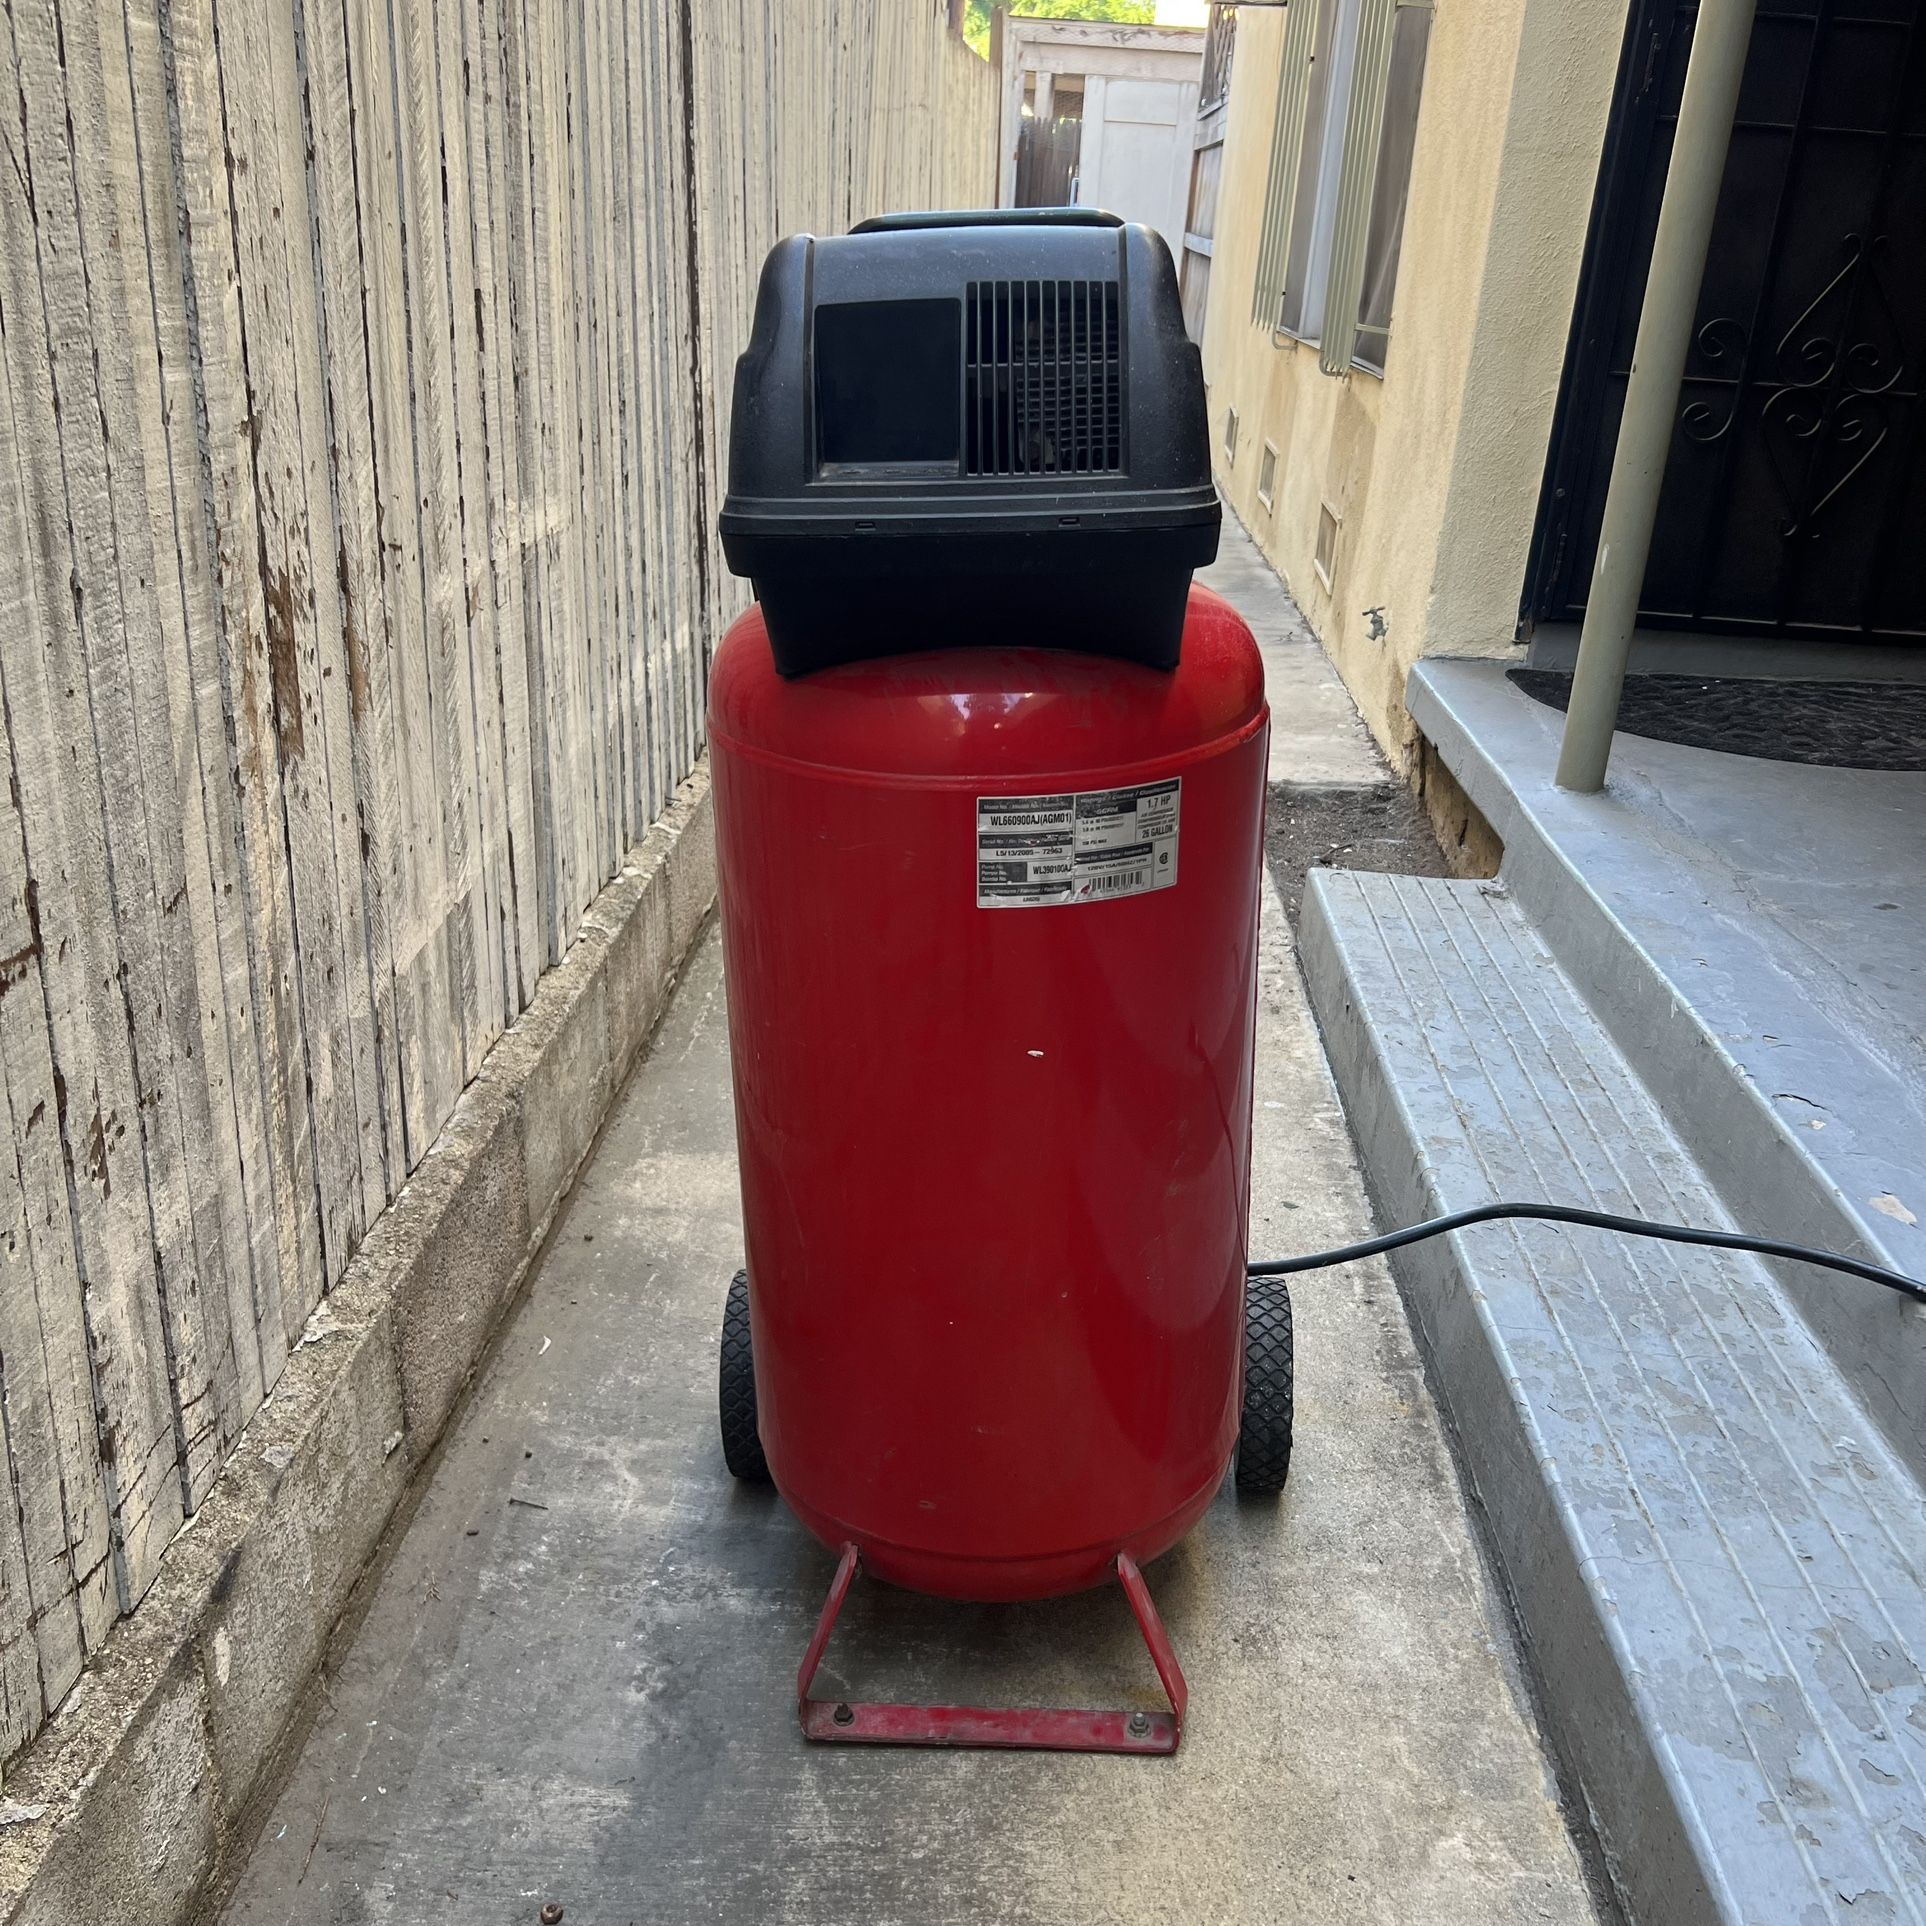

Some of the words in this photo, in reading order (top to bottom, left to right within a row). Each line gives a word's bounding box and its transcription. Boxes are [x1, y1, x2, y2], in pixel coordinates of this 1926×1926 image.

[1147, 797, 1158, 809] 1.7
[1160, 794, 1171, 806] HP
[990, 812, 1072, 826] WL660900AJ(AGM01)
[1151, 824, 1173, 837] GALLON
